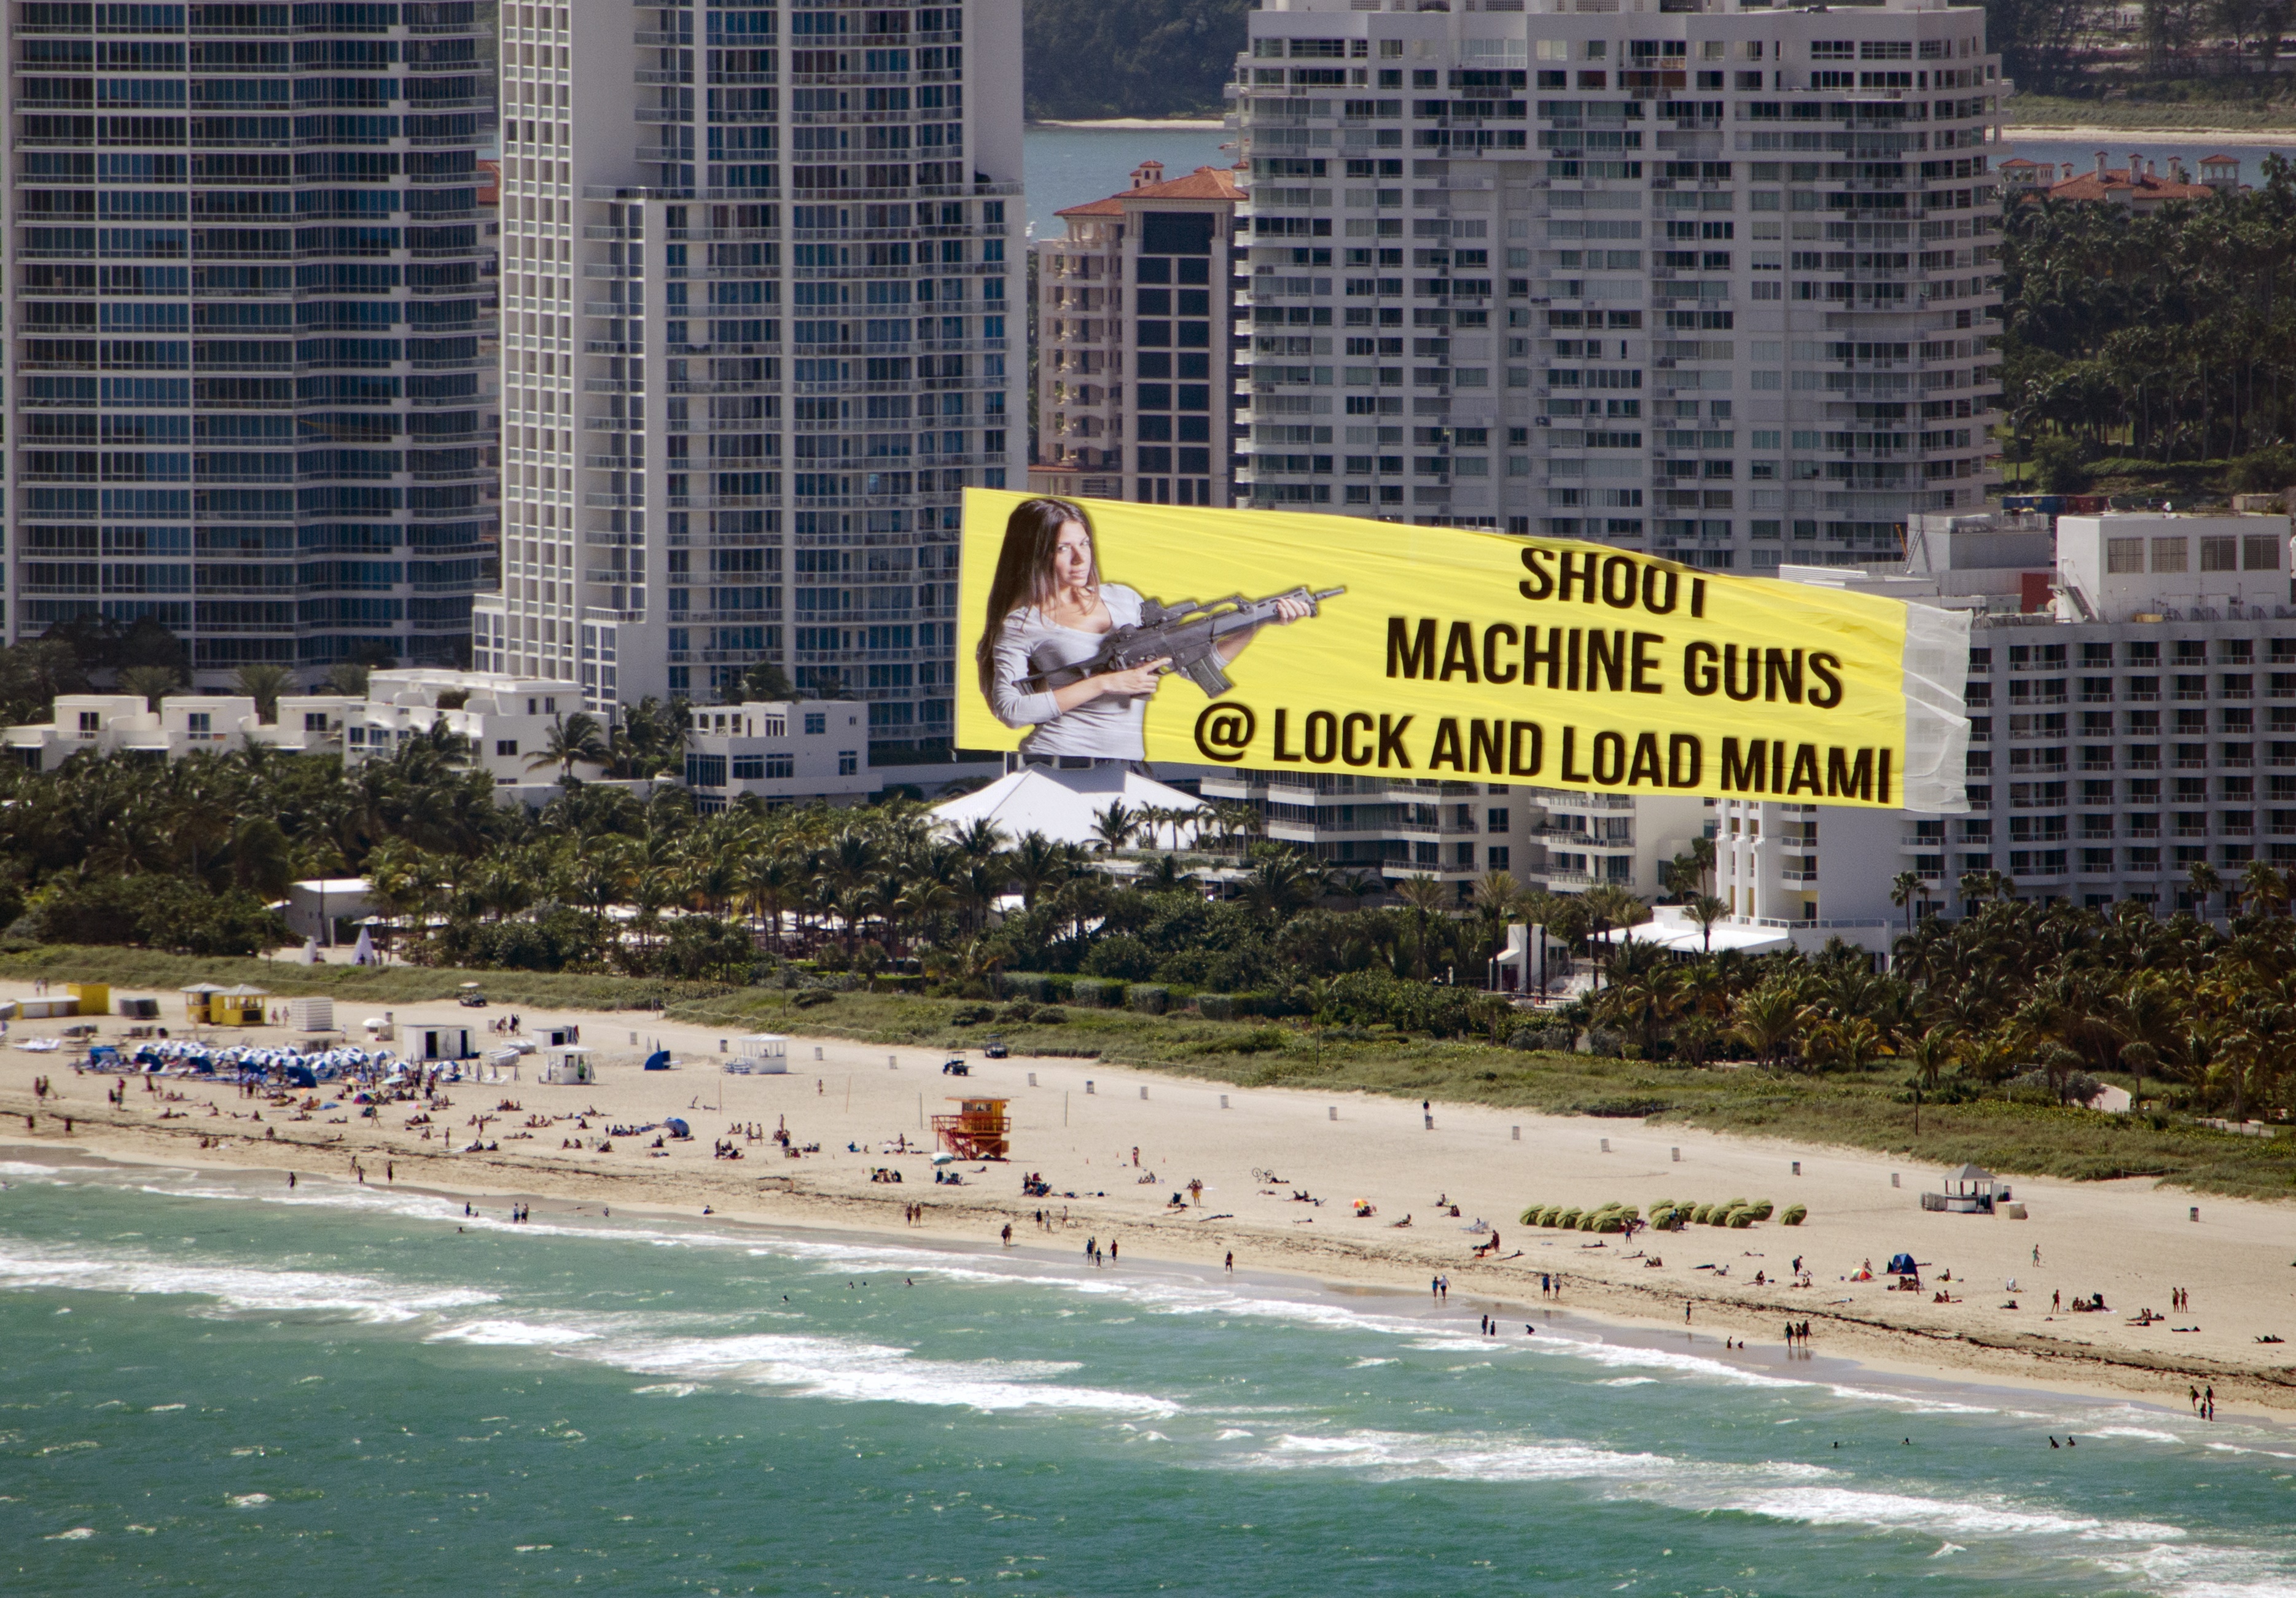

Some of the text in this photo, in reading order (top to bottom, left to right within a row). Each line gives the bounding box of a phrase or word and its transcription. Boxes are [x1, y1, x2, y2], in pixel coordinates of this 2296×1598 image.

[1386, 617, 1842, 709] MACHINE GUNS
[1194, 702, 1891, 804] @ LOCK AND LOAD MIAMI
